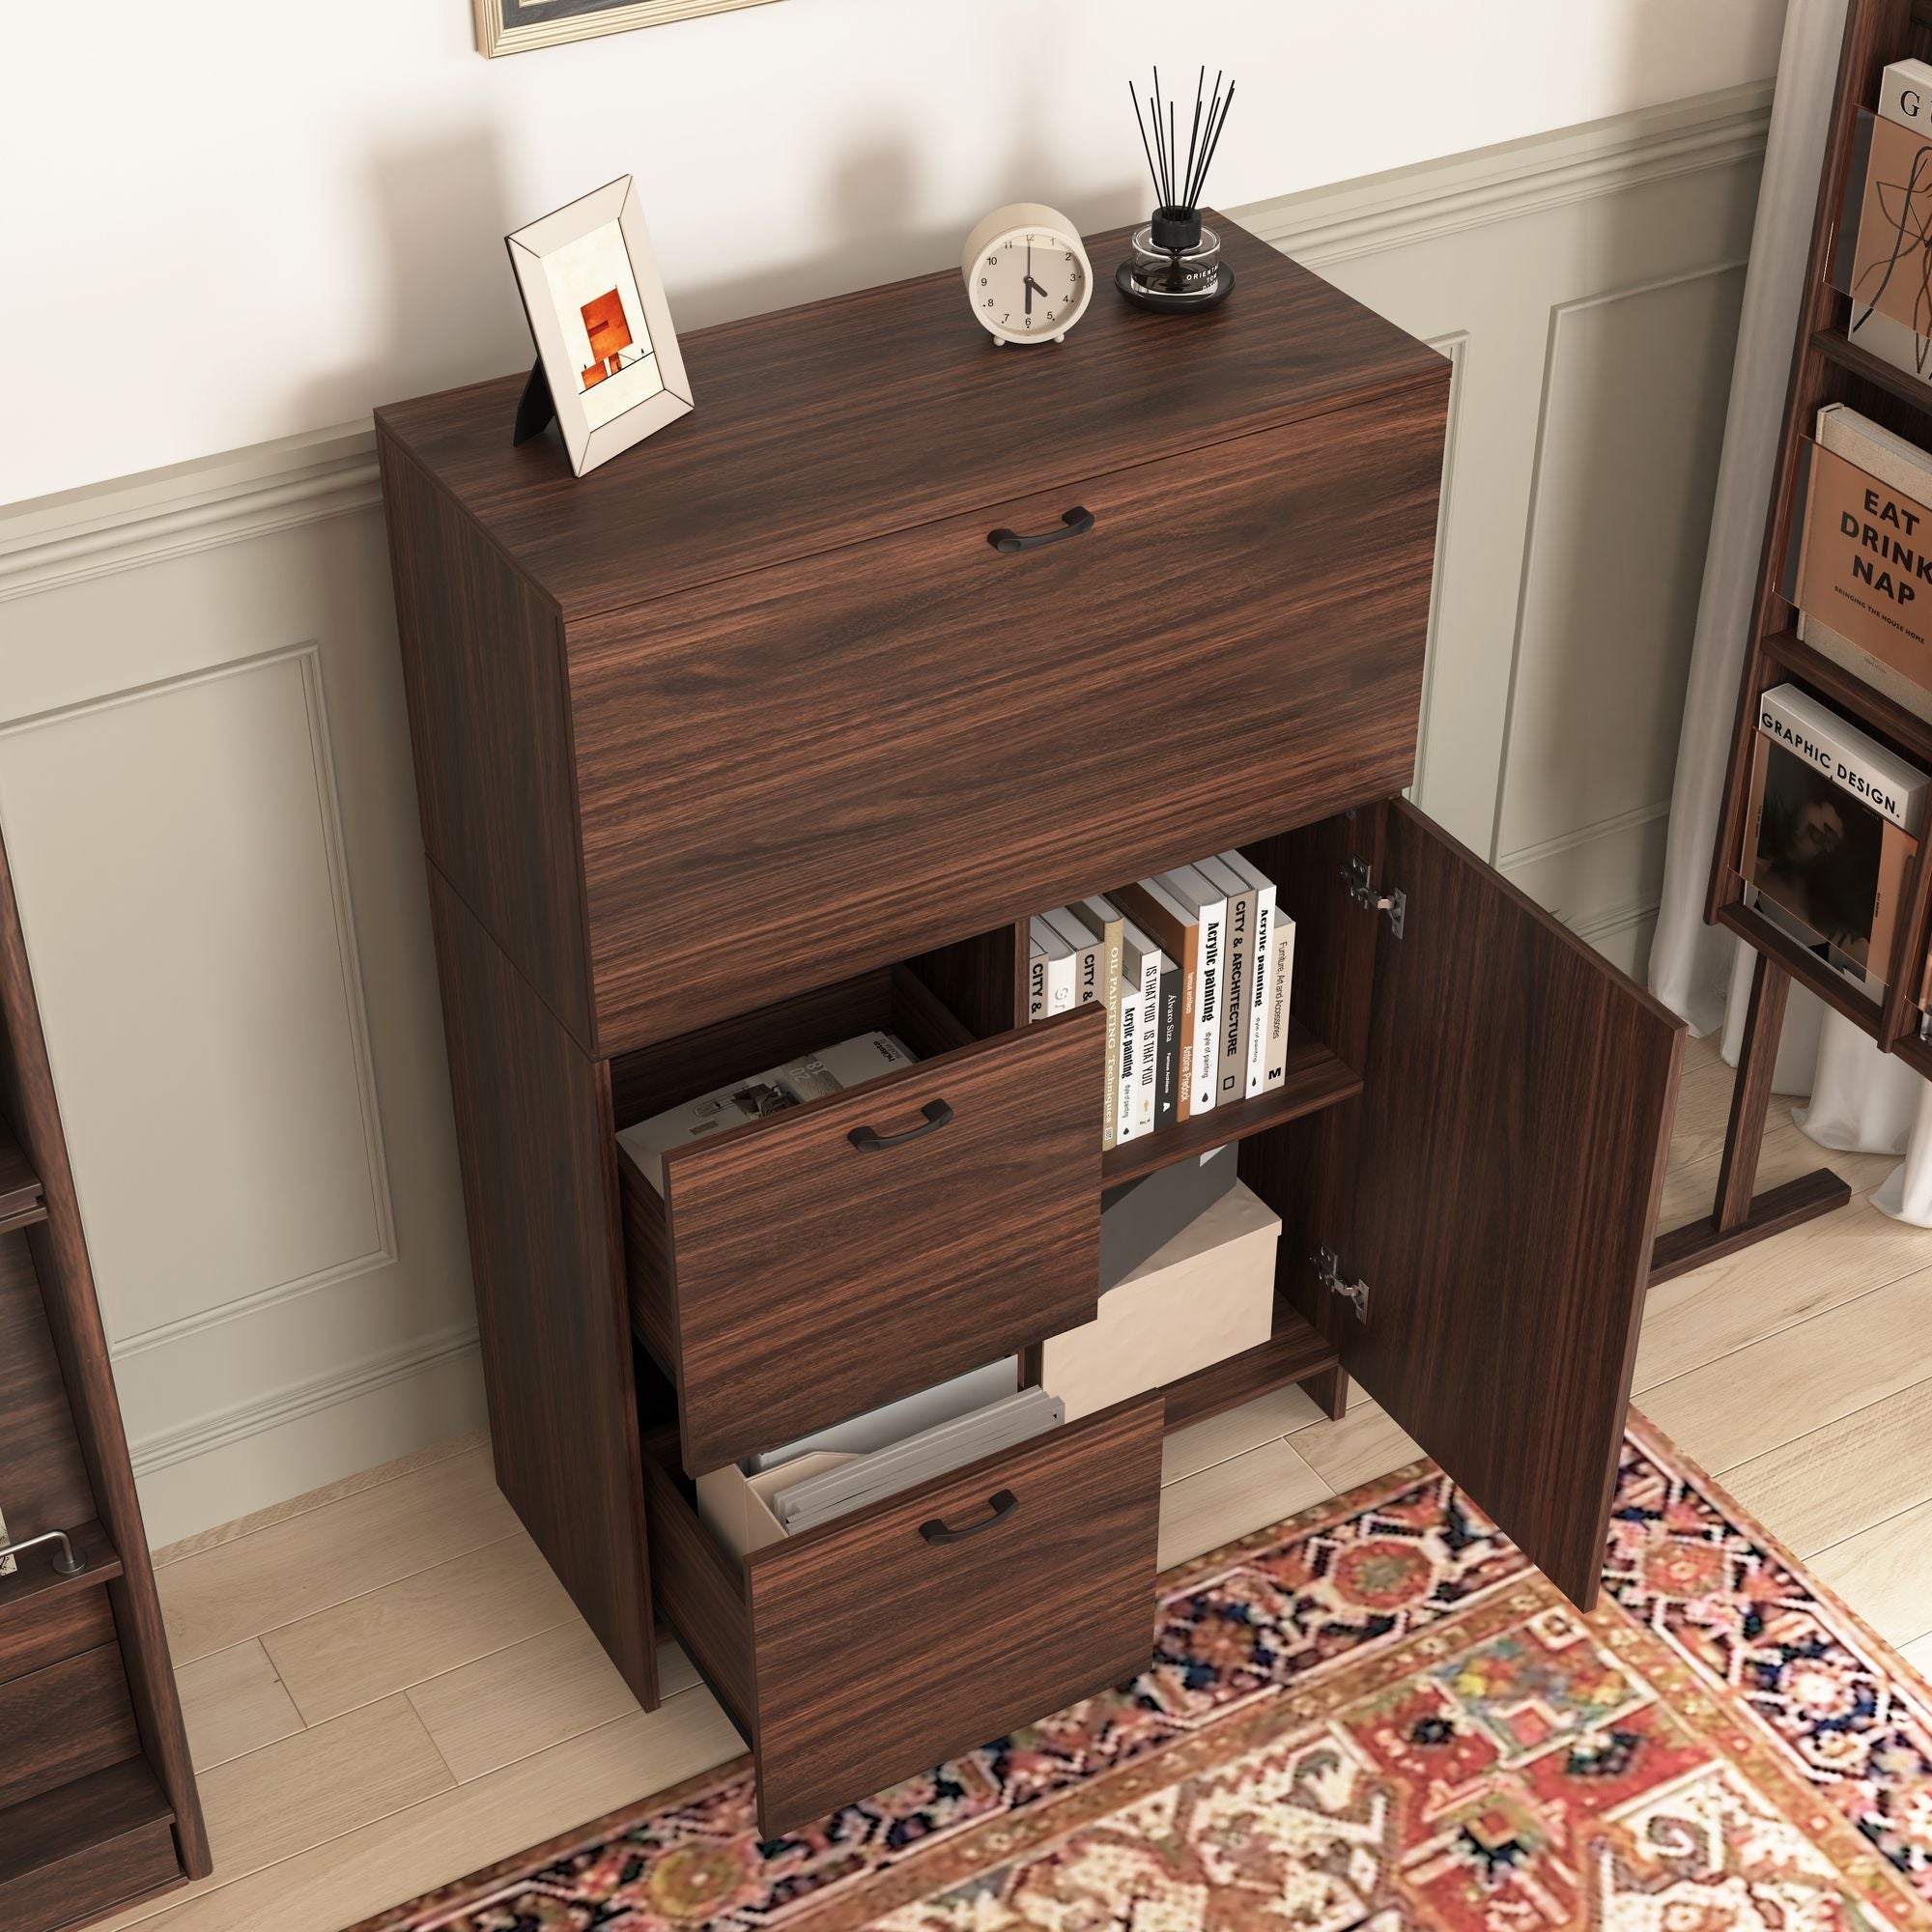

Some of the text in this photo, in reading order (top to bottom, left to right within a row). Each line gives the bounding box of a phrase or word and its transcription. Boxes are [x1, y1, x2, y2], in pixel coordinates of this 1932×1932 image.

[986, 256, 997, 266] 10
[1005, 241, 1012, 249] 11
[1065, 252, 1071, 261] 2
[1069, 273, 1076, 282] 3
[988, 298, 994, 307] 8
[1863, 488, 1920, 536] EAT
[1840, 510, 1932, 585] DRINK
[1853, 554, 1916, 605] NAP
[1834, 585, 1925, 645] BRINGING THE HOUSE HOME
[1761, 712, 1900, 818] GRAPHIC DESIGN.
[1206, 921, 1219, 966] Acrylic
[1259, 909, 1268, 952] Acrylic
[1033, 962, 1043, 997] CITY
[1082, 953, 1095, 1002] CITY &
[1110, 947, 1119, 975] OIL
[1146, 965, 1157, 977] IS
[1227, 900, 1246, 1057] CITY & ARCHITECTURE
[1254, 954, 1264, 1008] painting
[1031, 1002, 1042, 1013] &
[1145, 977, 1157, 1001] THAT
[1202, 968, 1216, 1022] painting
[1272, 941, 1288, 1039] Furniture, Art and Accessories
[1108, 977, 1118, 1049] PAINTING
[1123, 1007, 1135, 1038] Acrylic
[1143, 1040, 1154, 1064] THAT
[1144, 1029, 1154, 1040] IS
[1122, 1039, 1134, 1079] painting
[1180, 1045, 1192, 1102] Antoine Predock
[1268, 1066, 1282, 1080] M
[1104, 1055, 1116, 1122] Techniques
